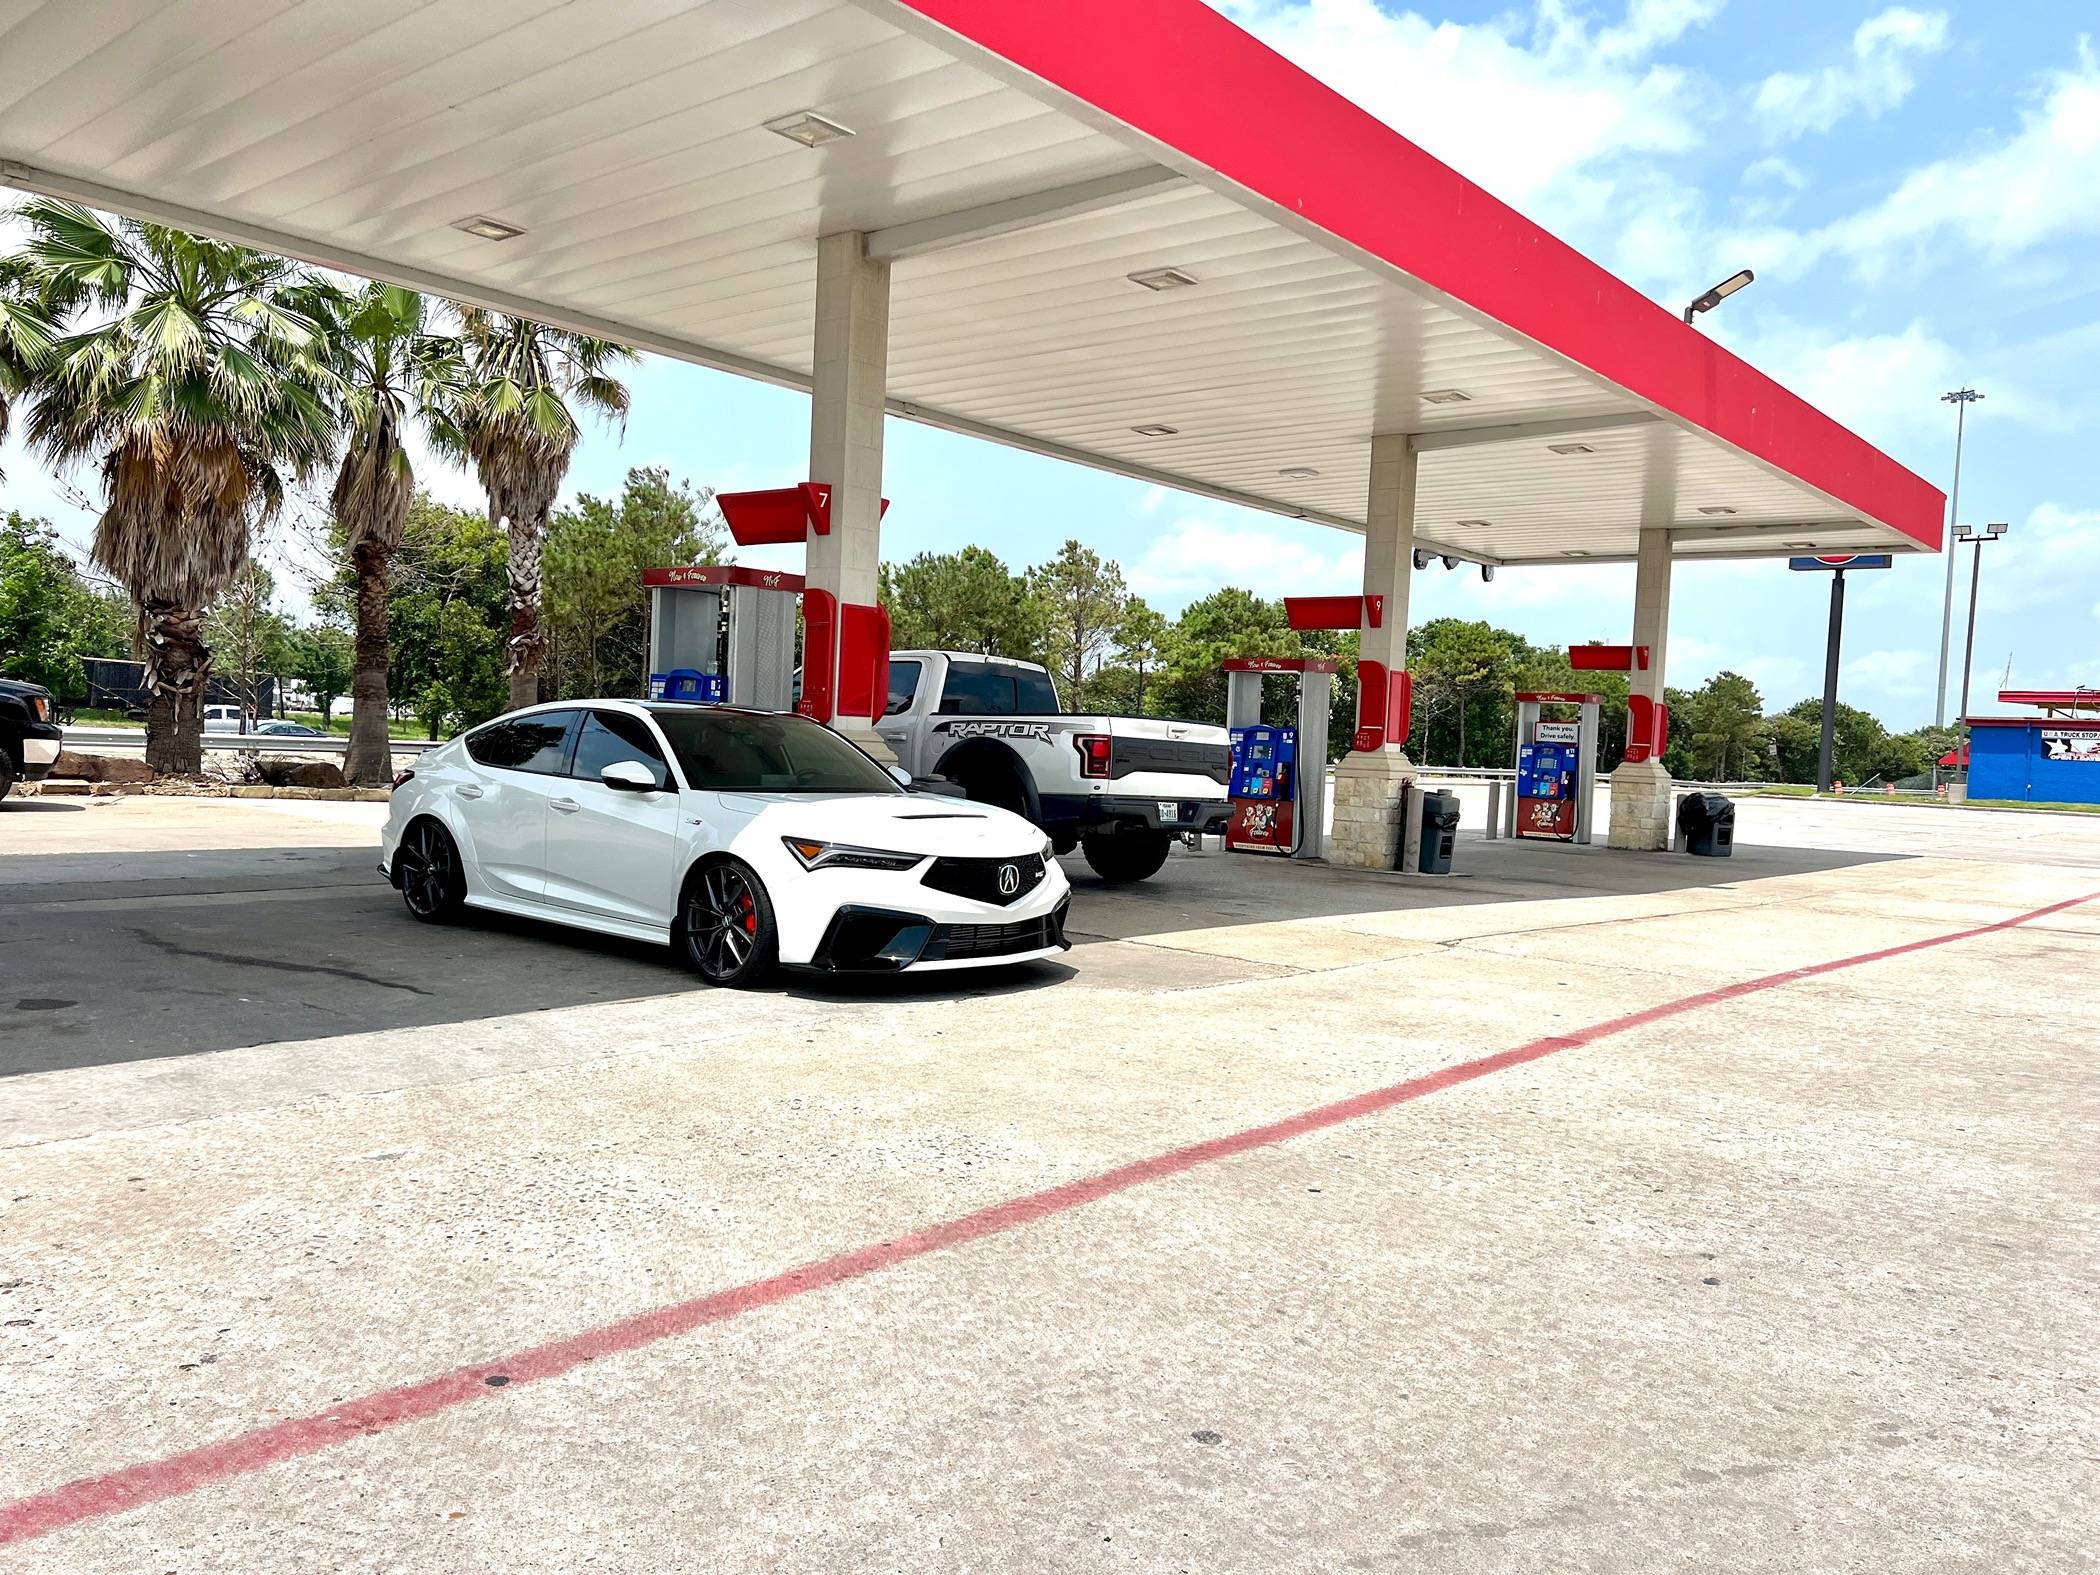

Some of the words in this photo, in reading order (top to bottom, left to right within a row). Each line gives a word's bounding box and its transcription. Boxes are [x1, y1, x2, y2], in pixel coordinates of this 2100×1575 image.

[819, 492, 828, 507] 7
[1376, 600, 1381, 611] 9
[948, 721, 1055, 748] RAPTOR
[1562, 725, 1574, 733] you.
